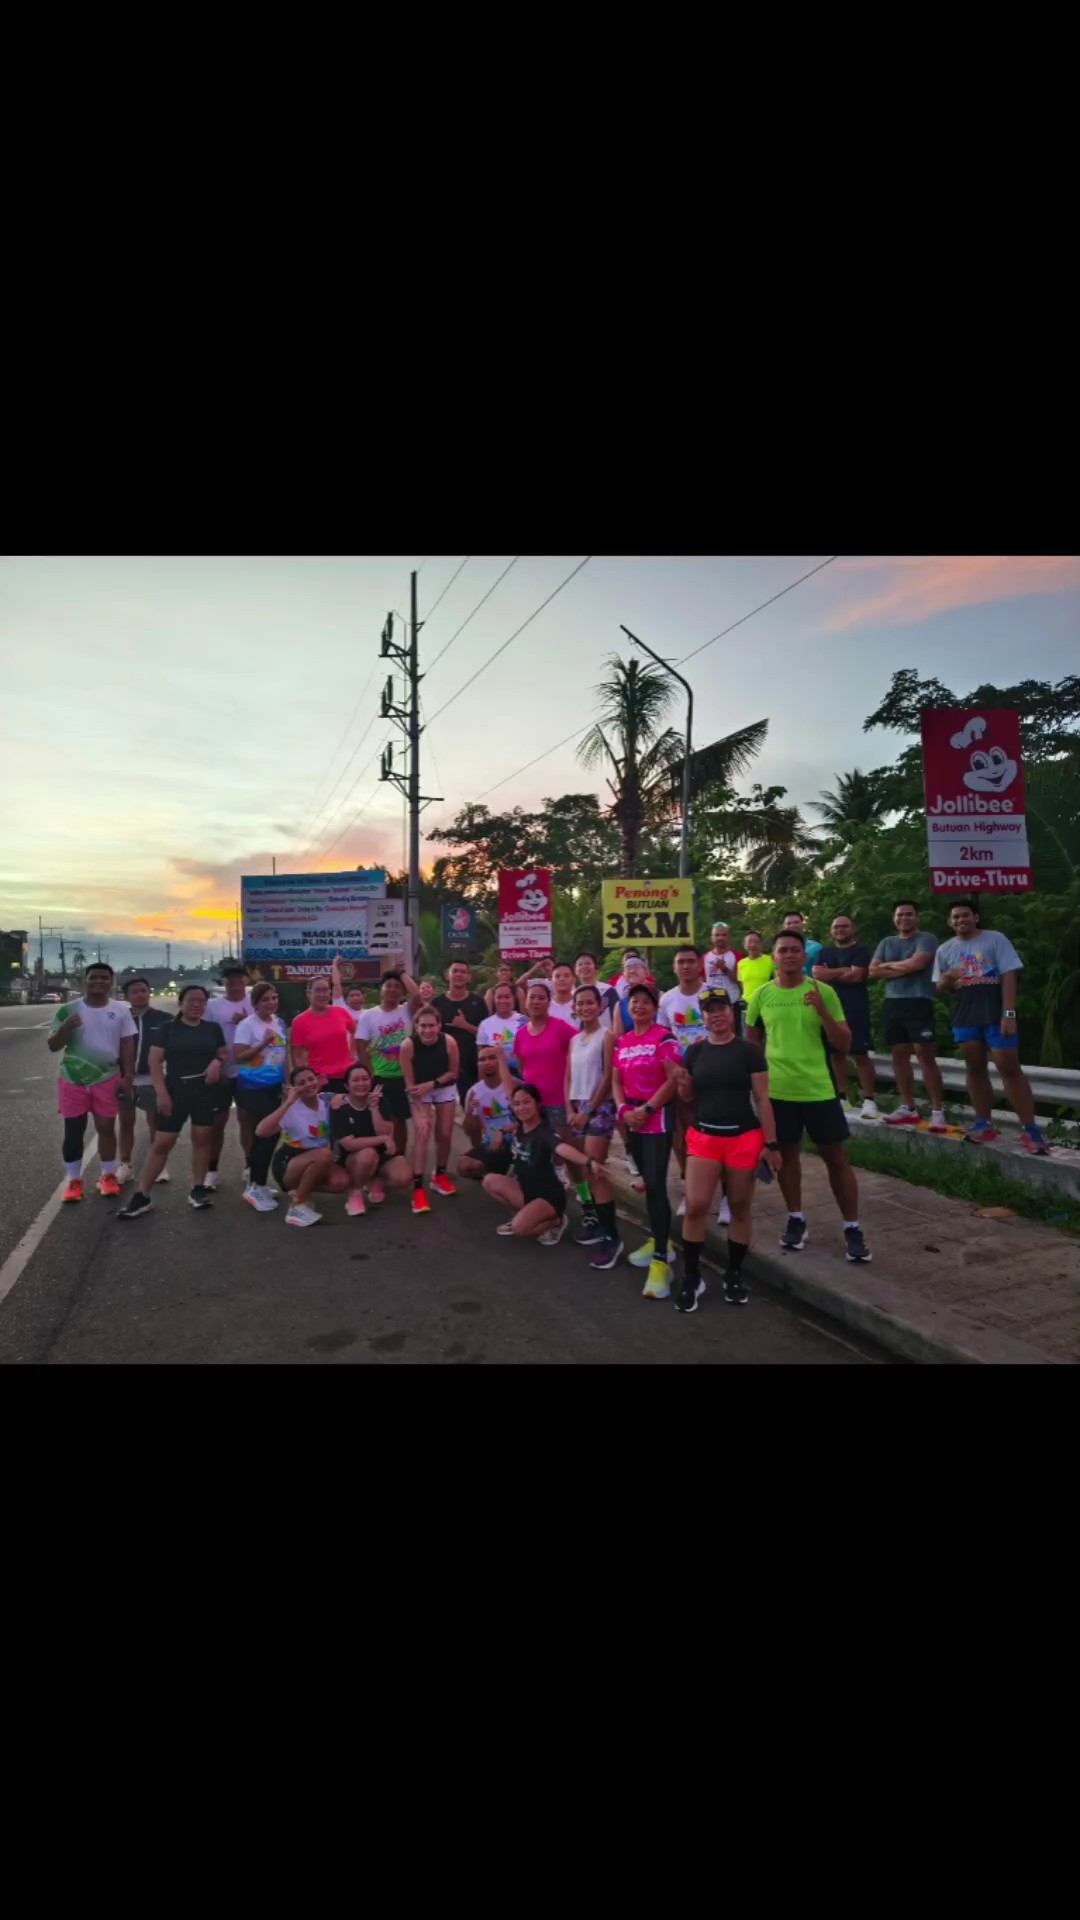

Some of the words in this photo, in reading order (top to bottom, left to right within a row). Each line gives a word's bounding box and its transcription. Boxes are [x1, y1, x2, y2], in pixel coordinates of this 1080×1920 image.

[930, 794, 1015, 814] Jollibee
[932, 822, 971, 833] Butuan
[974, 822, 1022, 835] Highway
[959, 846, 994, 861] 2km
[932, 870, 1028, 888] Drive-Thru
[615, 885, 681, 900] Penong's
[626, 900, 670, 909] BUTUAN
[501, 910, 545, 922] Jollibee
[606, 912, 691, 940] 3KM
[278, 938, 335, 947] DISIPLINA
[285, 965, 333, 975] TANDUAY
